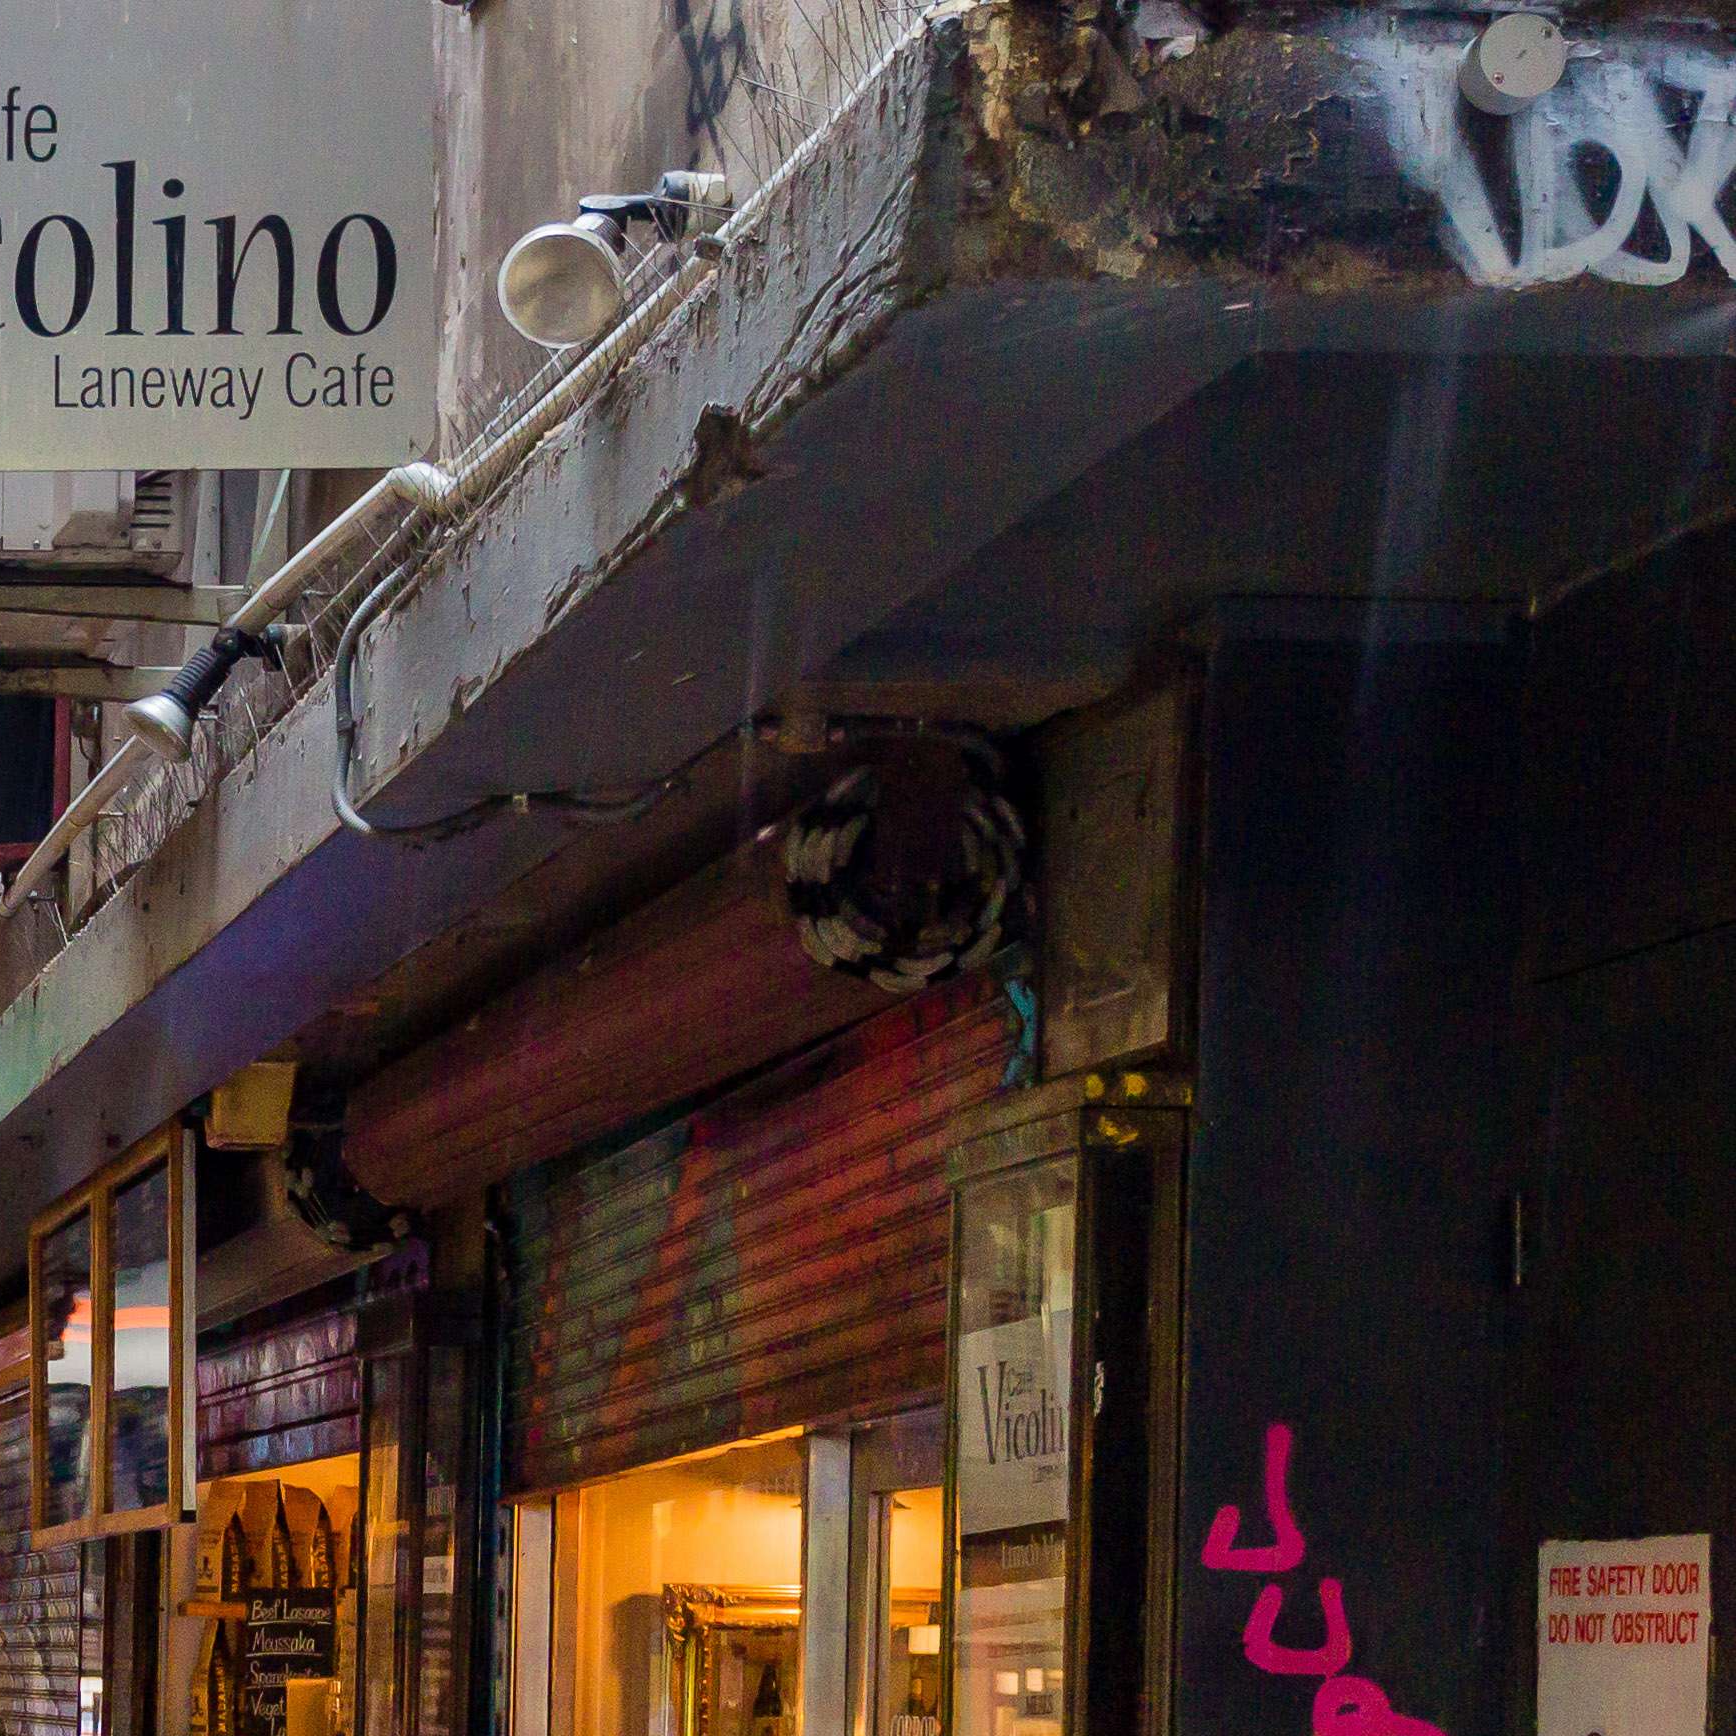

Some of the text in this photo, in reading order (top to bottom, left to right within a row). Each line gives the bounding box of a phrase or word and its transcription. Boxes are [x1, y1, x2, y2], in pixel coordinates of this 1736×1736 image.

[52, 351, 396, 420] Laneway Cafe
[1548, 1562, 1700, 1597] FIRE SAFETY DOOR
[251, 1599, 279, 1622] Beef
[1548, 1611, 1699, 1645] DO NOT OBSTRUCT
